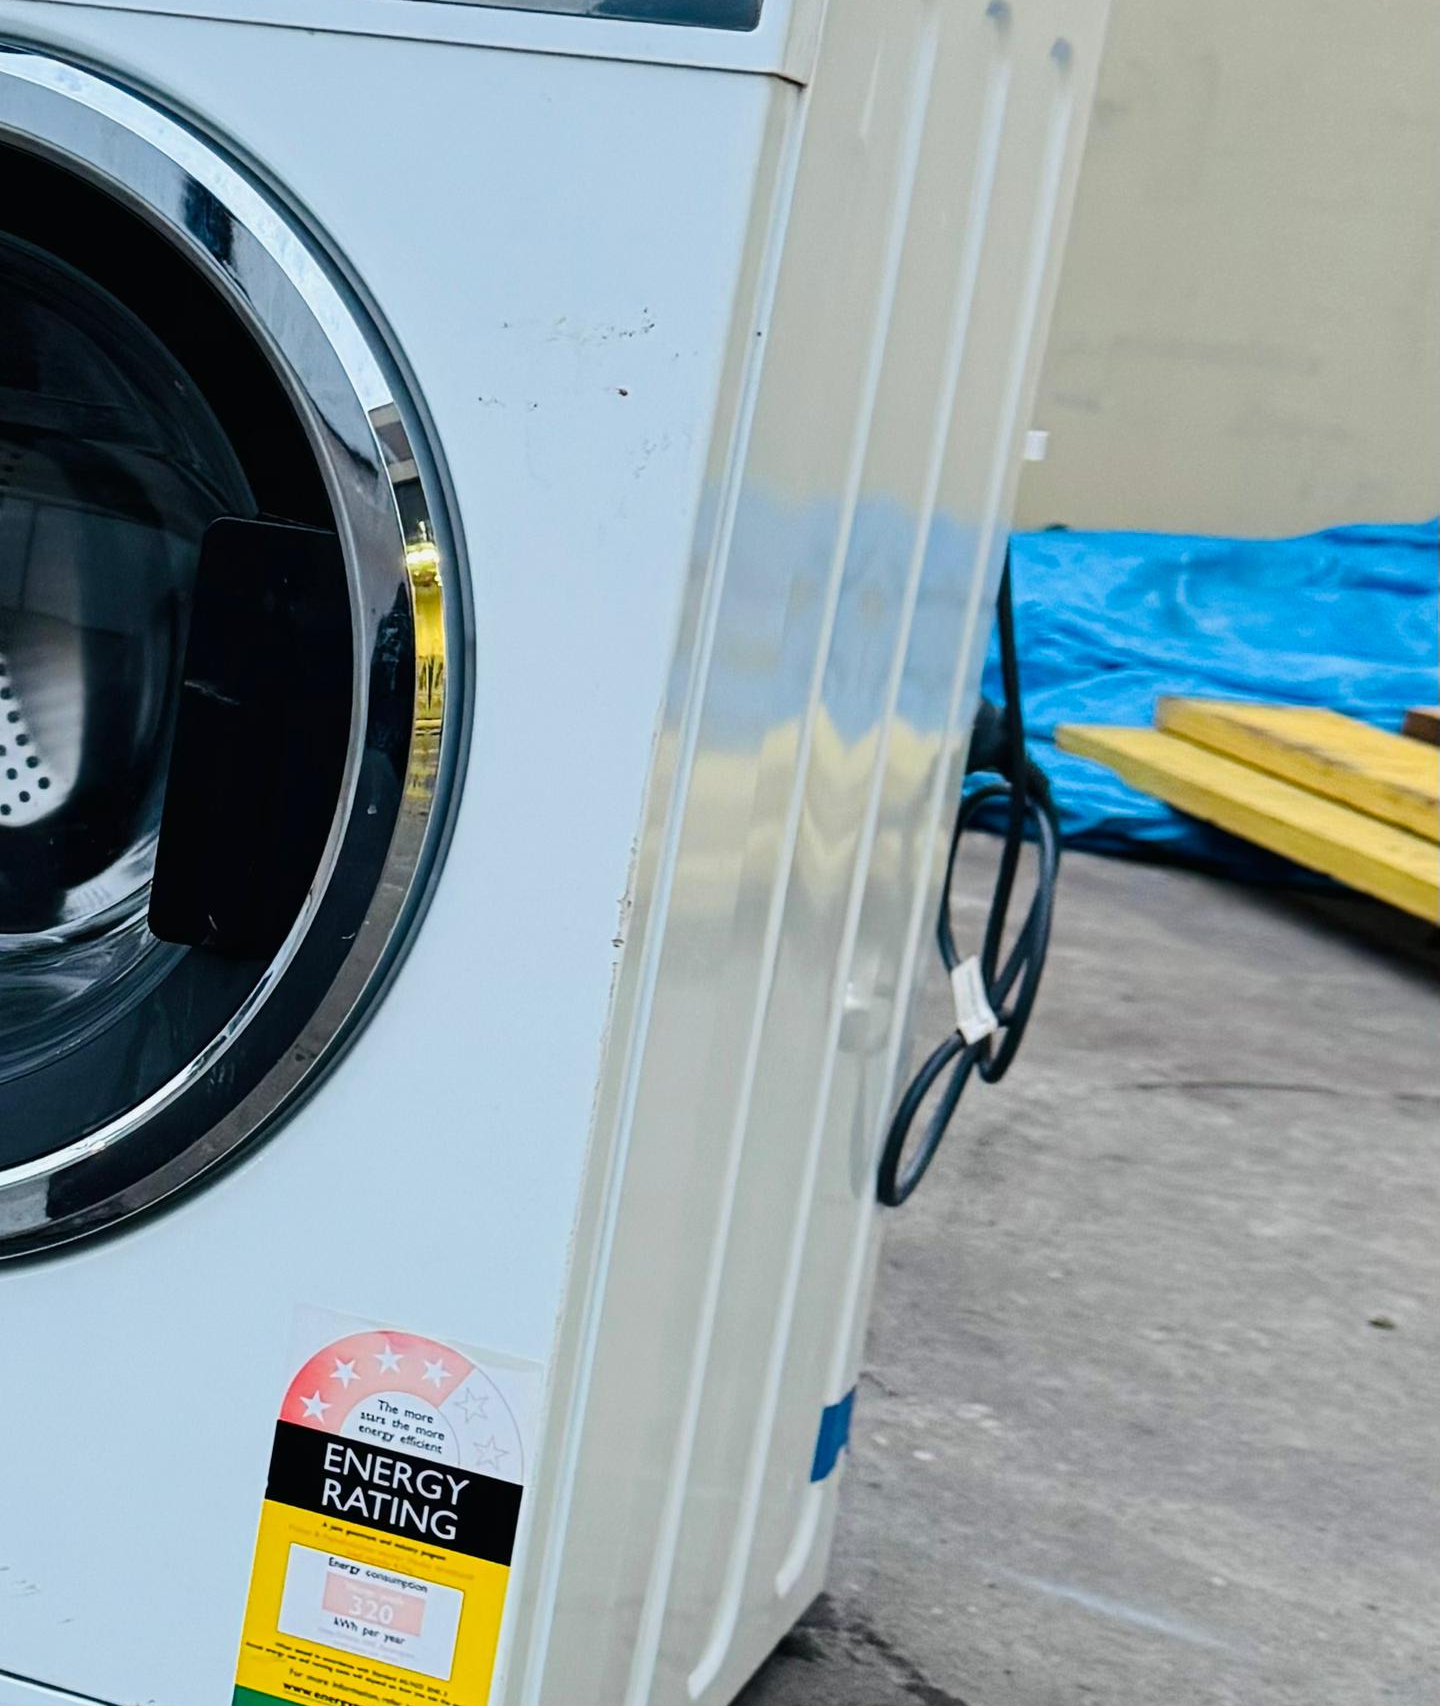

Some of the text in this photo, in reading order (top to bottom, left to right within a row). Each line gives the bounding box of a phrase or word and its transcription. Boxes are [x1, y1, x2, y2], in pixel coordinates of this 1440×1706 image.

[360, 1411, 445, 1441] stars the more
[378, 1398, 434, 1424] The more
[358, 1425, 443, 1454] energy efficient
[323, 1442, 470, 1506] ENERGY
[321, 1478, 459, 1541] RATING
[328, 1556, 361, 1575] Energy
[365, 1570, 428, 1593] consumption
[348, 1594, 395, 1625] 320
[333, 1615, 406, 1645] kWh per year
